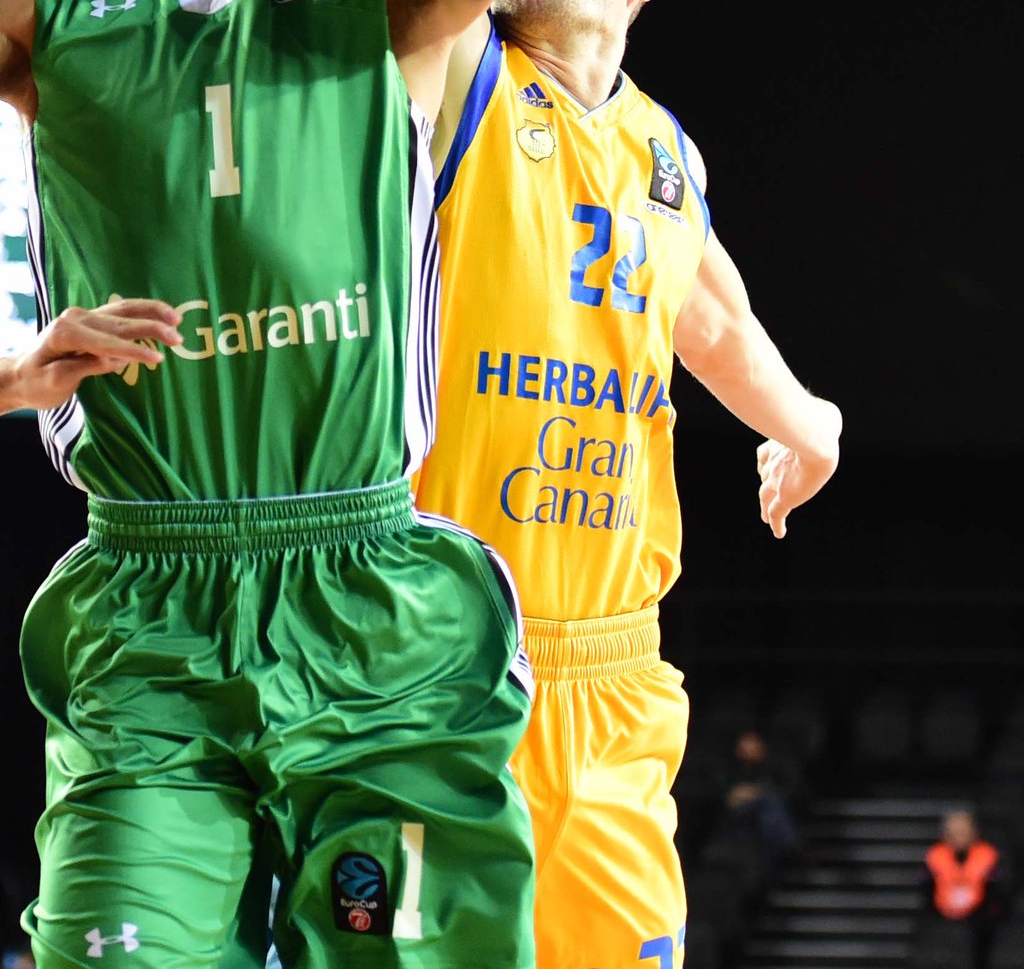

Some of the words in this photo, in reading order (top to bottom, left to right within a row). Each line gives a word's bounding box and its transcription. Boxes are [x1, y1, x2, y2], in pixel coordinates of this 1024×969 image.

[205, 84, 241, 198] 1
[569, 203, 647, 314] 22
[169, 283, 371, 361] Garanti
[392, 822, 425, 940] 1
